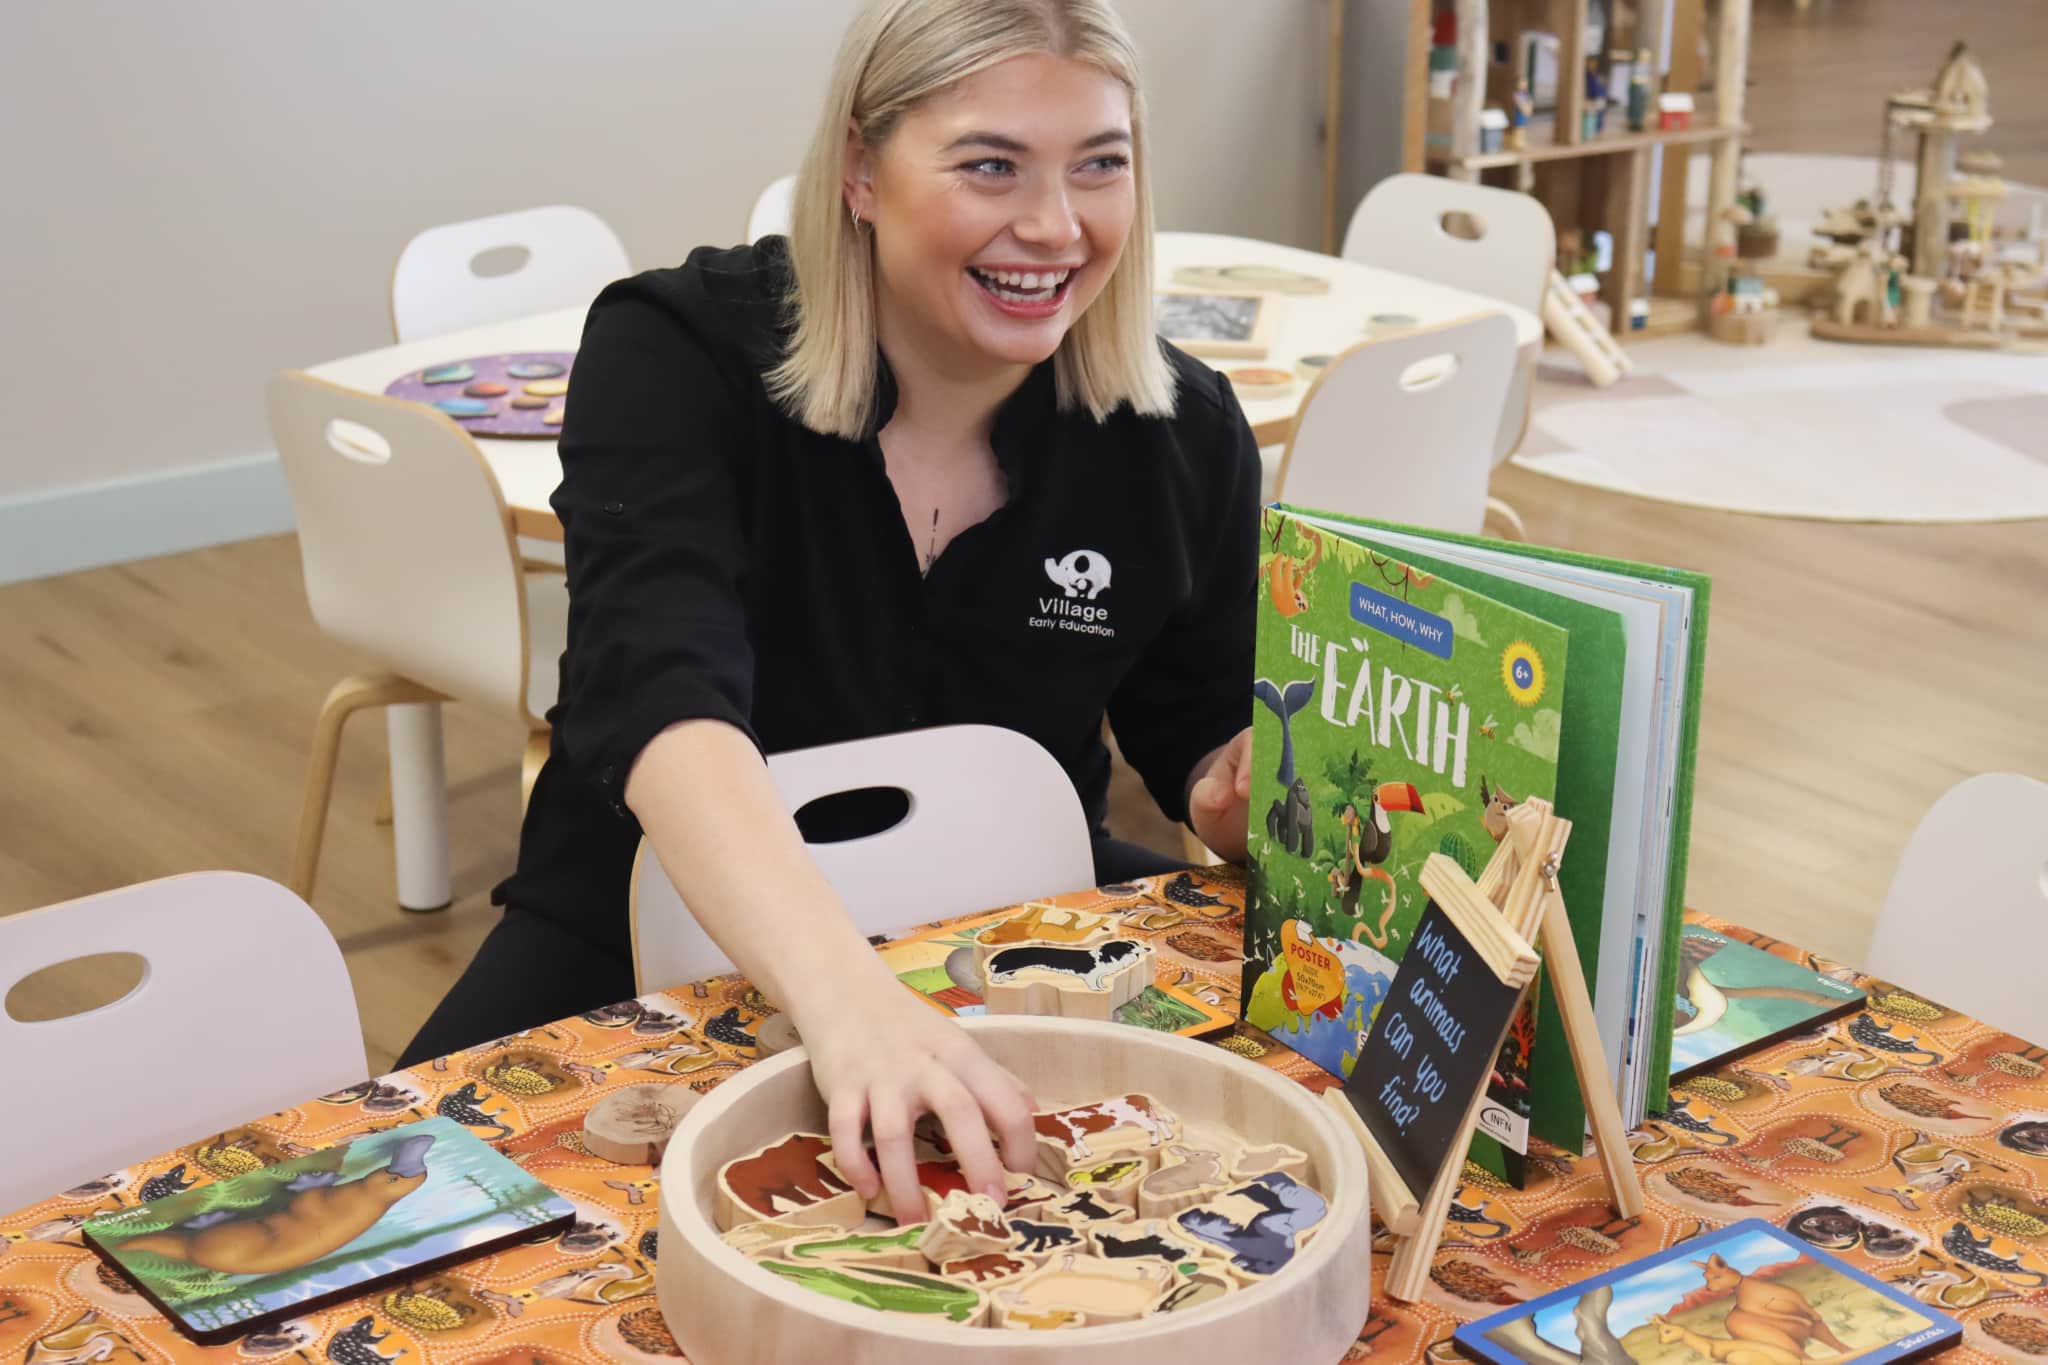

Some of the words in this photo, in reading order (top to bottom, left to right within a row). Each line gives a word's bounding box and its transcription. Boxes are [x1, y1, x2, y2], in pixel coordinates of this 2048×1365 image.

[1029, 617, 1056, 630] Early
[1059, 619, 1115, 637] Education
[1039, 597, 1108, 622] Village
[1358, 596, 1389, 623] WHAT,
[1390, 610, 1418, 636] HOW,
[1419, 622, 1443, 643] WHY
[1515, 665, 1529, 680] 6+
[1289, 623, 1320, 667] THE
[1321, 641, 1470, 788] EARTH
[1291, 943, 1331, 971] POSTER
[1416, 920, 1462, 985] What
[1409, 977, 1466, 1055] animals
[1413, 1054, 1447, 1103] you
[1378, 1075, 1420, 1136] find?
